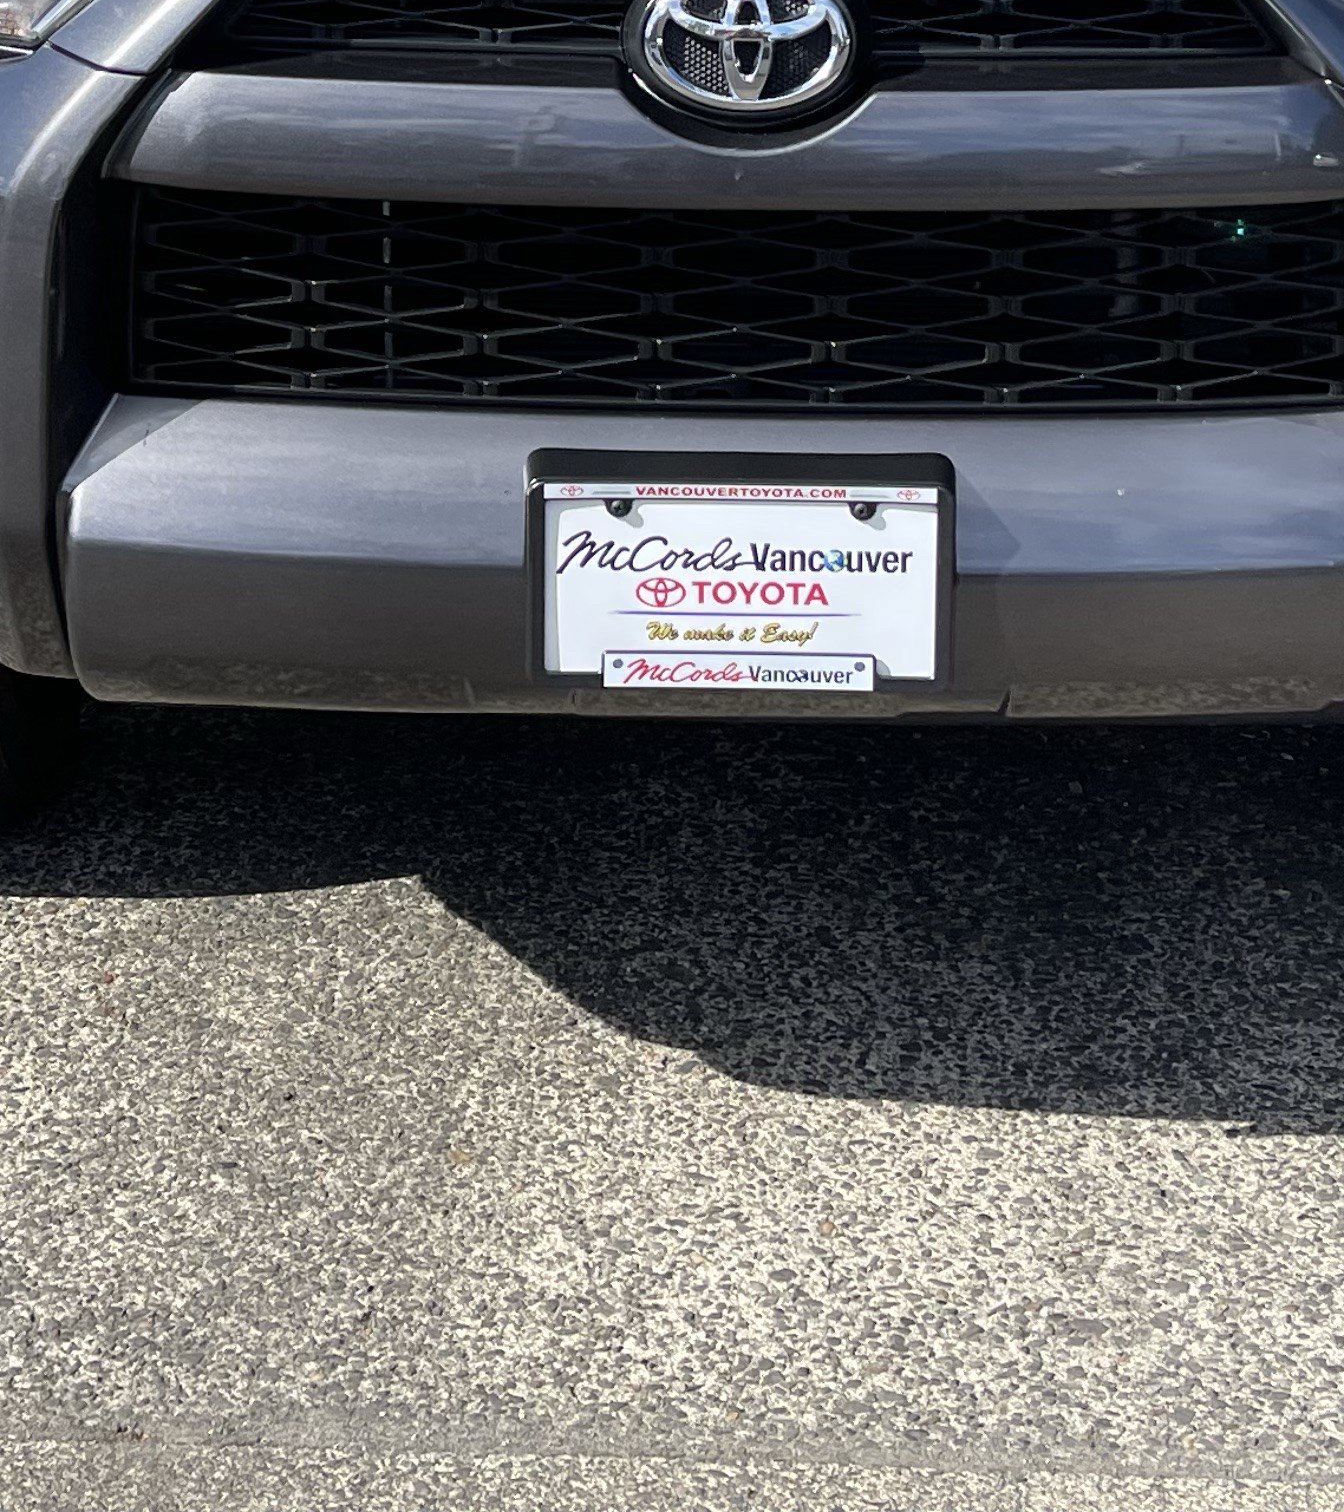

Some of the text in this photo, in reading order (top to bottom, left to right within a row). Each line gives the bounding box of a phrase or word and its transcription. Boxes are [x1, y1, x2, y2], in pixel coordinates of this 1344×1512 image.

[636, 486, 847, 499] VANCOUVERTOYOTA.COM
[556, 530, 913, 574] McCords Vancouver
[692, 582, 829, 606] TOYOTA
[646, 621, 819, 647] We make it Easy!
[623, 657, 854, 685] McCords Vancouver
